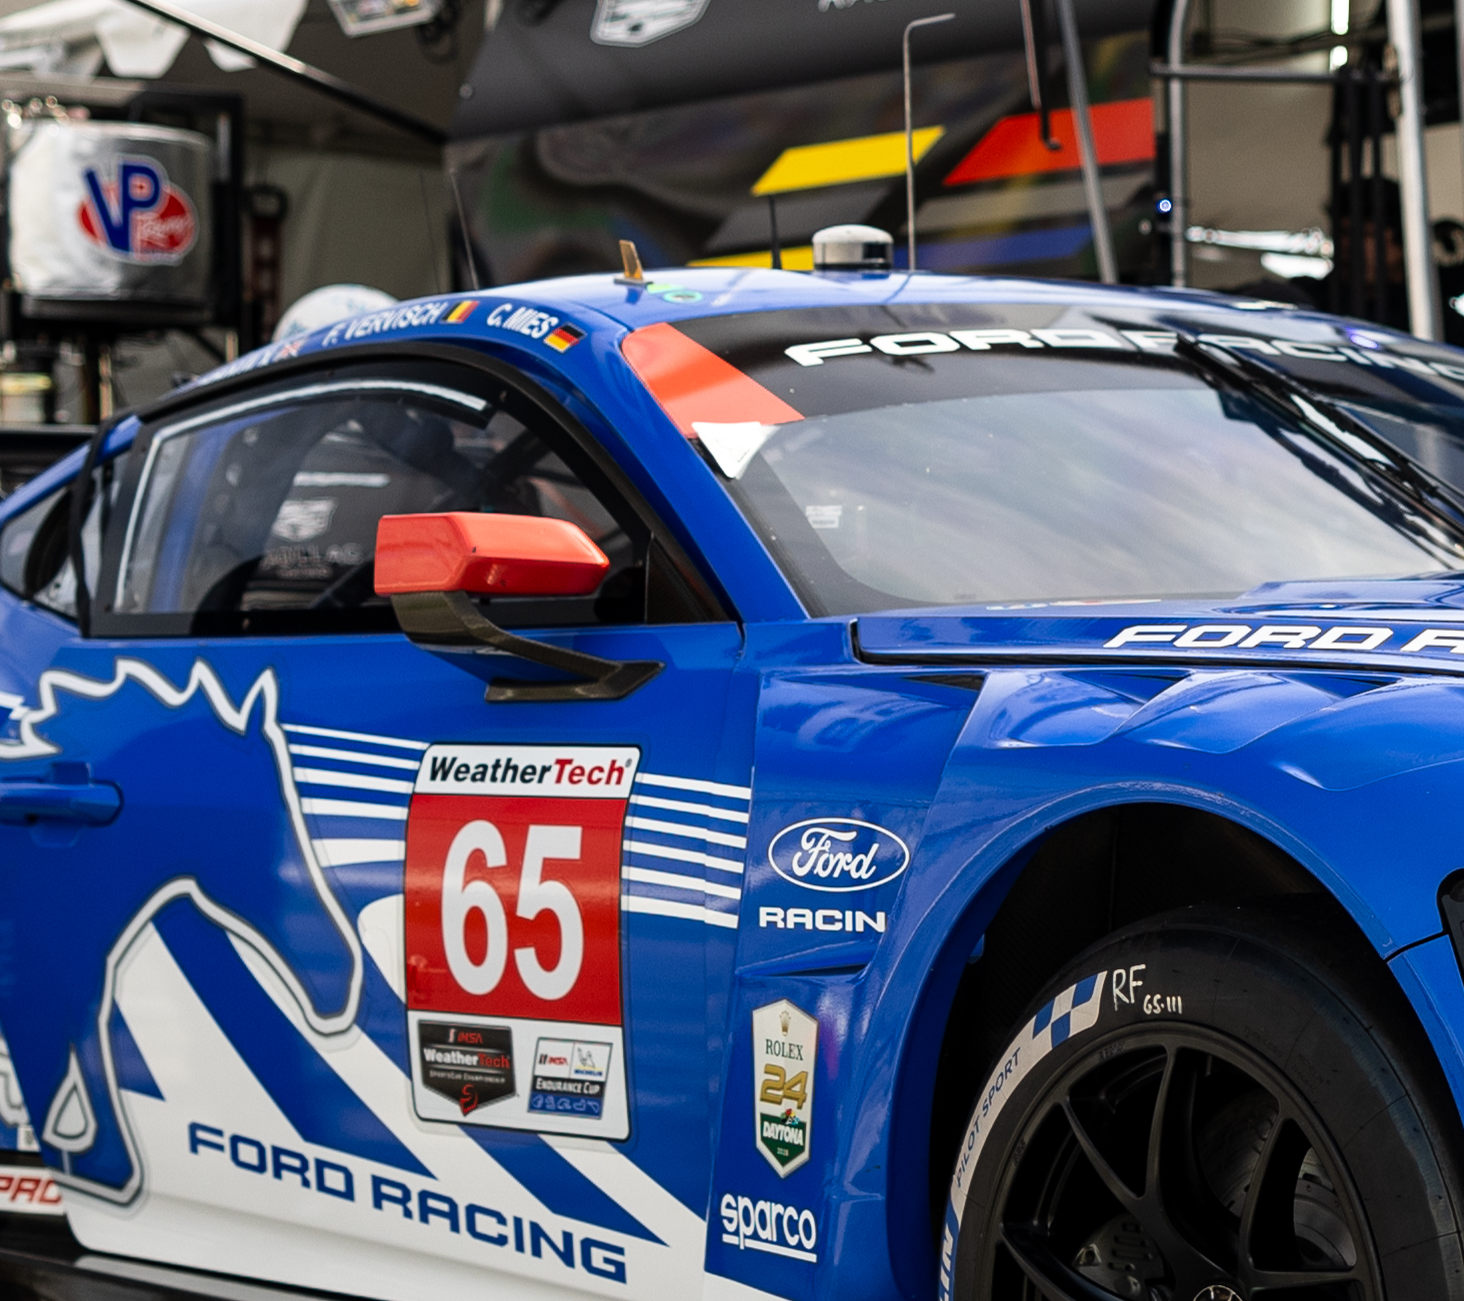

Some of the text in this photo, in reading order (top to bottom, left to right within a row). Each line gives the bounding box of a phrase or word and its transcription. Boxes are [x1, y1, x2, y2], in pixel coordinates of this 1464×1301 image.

[83, 161, 162, 253] VP
[344, 301, 443, 342] VERVISCH
[503, 306, 560, 340] MIES
[785, 328, 1121, 368] FORD
[1103, 623, 1396, 654] FORD
[430, 756, 625, 787] WeatherTech
[792, 826, 880, 880] Ford
[441, 818, 584, 1001] 65
[1112, 964, 1146, 1011] RF
[423, 1047, 511, 1069] WeatherTech
[765, 1038, 804, 1062] ROLEX
[760, 1063, 809, 1110] 24
[762, 1121, 805, 1148] DAYTONA
[954, 1046, 1022, 1189] SPORT PILOT
[188, 1121, 627, 1286] FORD RACING
[720, 1192, 817, 1255] sparco
